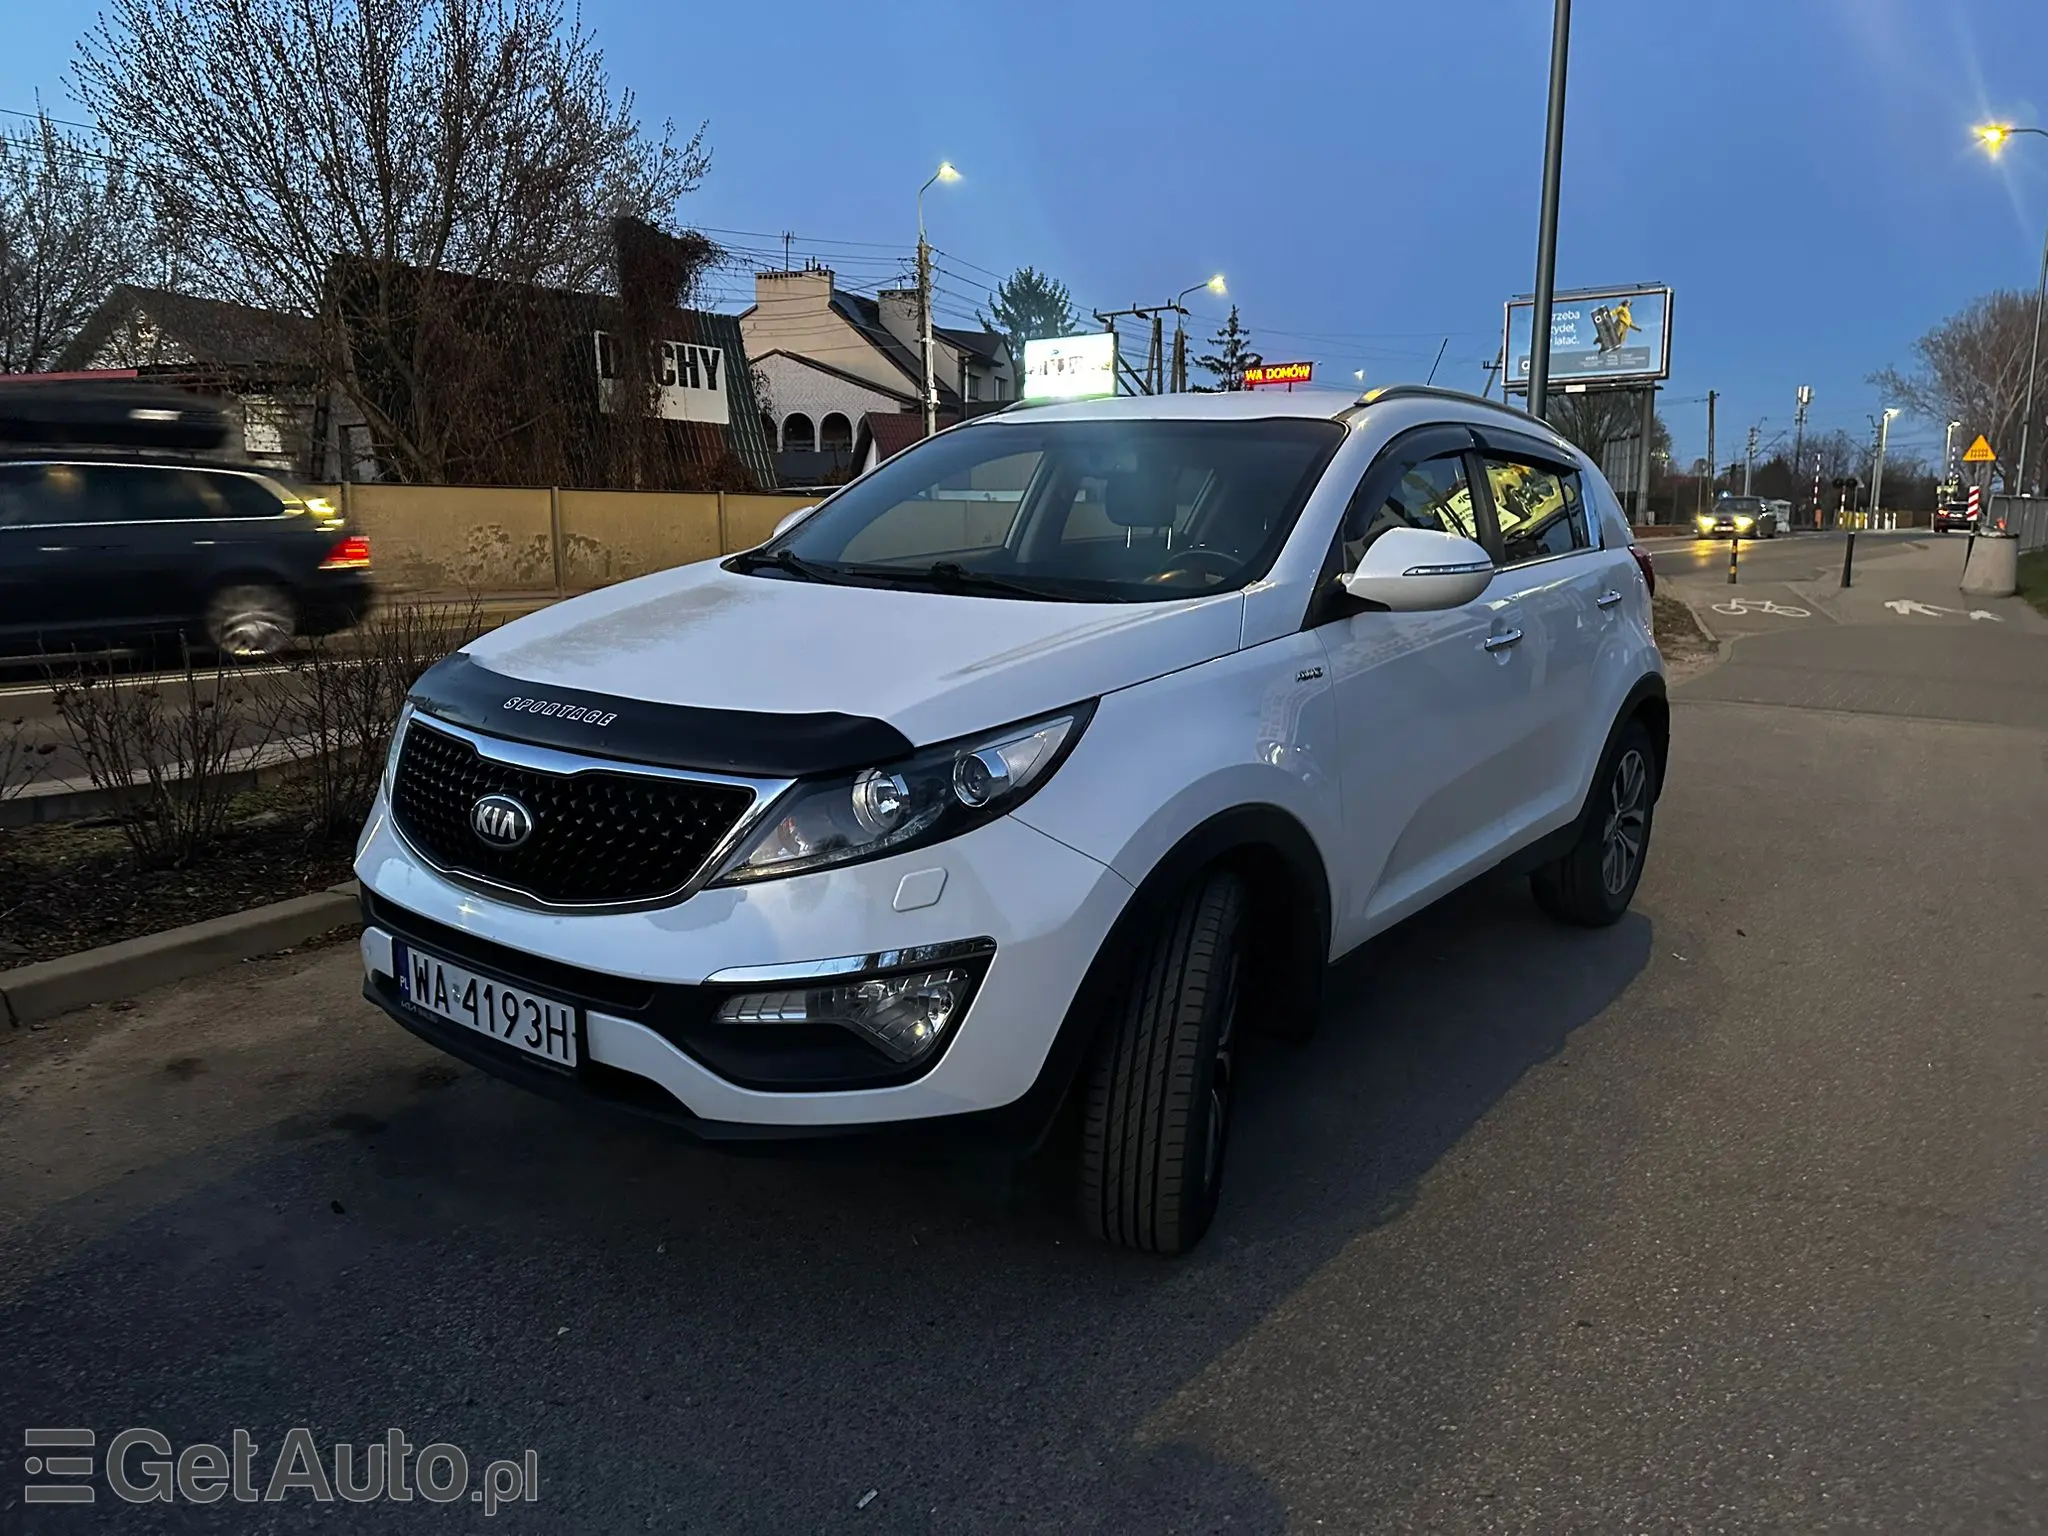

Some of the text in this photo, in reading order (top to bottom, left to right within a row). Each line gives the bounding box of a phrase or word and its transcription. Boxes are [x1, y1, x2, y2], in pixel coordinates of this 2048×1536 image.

[1552, 310, 1580, 322] rzeba
[1245, 363, 1310, 380] WA DOMÓW
[503, 696, 618, 726] SPORTAGE
[476, 804, 517, 840] KIA
[400, 975, 409, 990] PL
